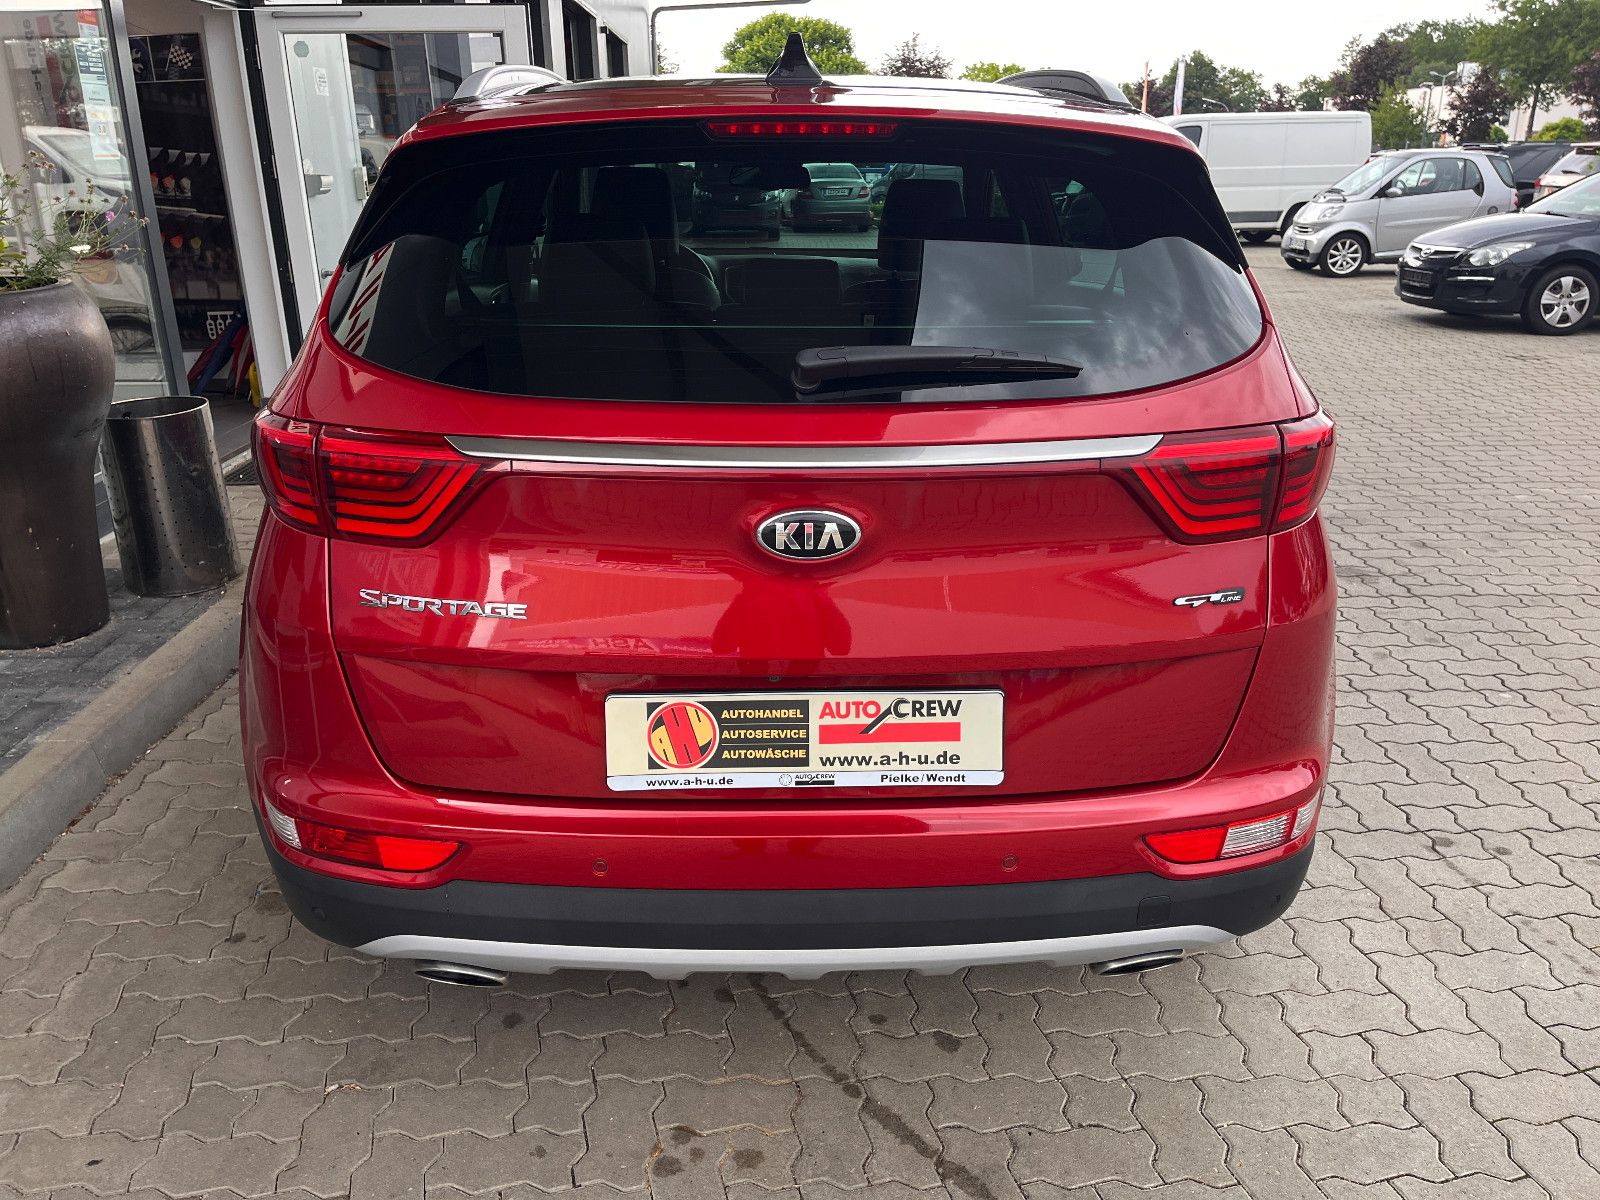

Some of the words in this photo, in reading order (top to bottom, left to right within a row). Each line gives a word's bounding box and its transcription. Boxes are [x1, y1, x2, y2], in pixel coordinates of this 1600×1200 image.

[774, 522, 844, 550] KIA
[359, 588, 528, 620] SPORTAGE
[1174, 591, 1238, 607] GT
[721, 709, 804, 719] AUTOHANDEL
[818, 700, 882, 719] AUTO
[890, 698, 963, 719] CREW
[721, 729, 807, 739] AUTOSERVICE
[721, 748, 807, 759] AUTOWÄSCHE
[818, 750, 962, 767] www.a-h-u.de
[645, 776, 734, 787] www.a-h-u.de
